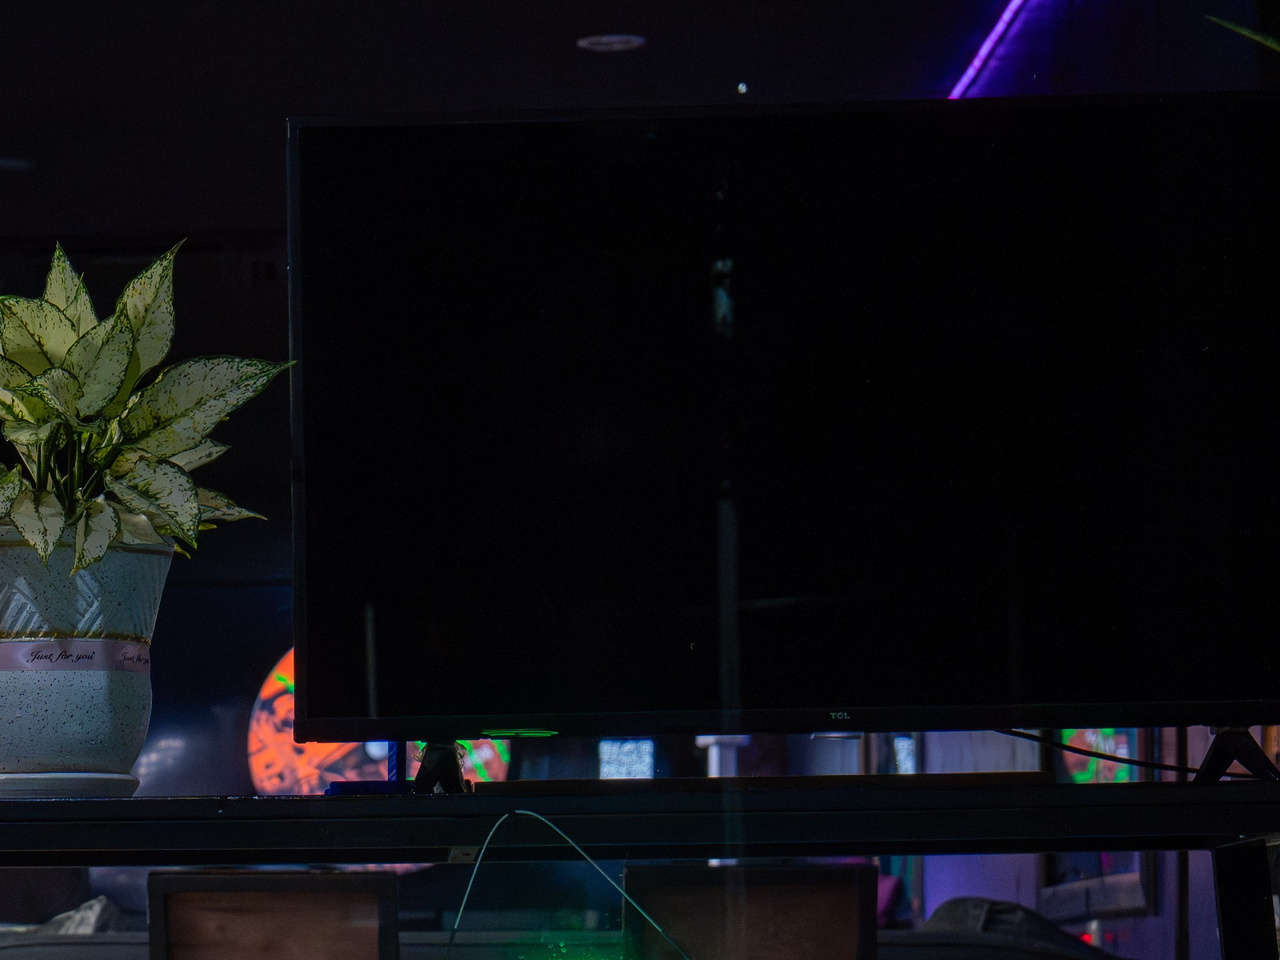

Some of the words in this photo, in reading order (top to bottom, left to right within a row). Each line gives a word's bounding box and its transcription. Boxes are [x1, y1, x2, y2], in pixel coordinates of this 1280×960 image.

[26, 650, 53, 664] Just
[50, 650, 73, 664] for
[71, 650, 96, 663] you
